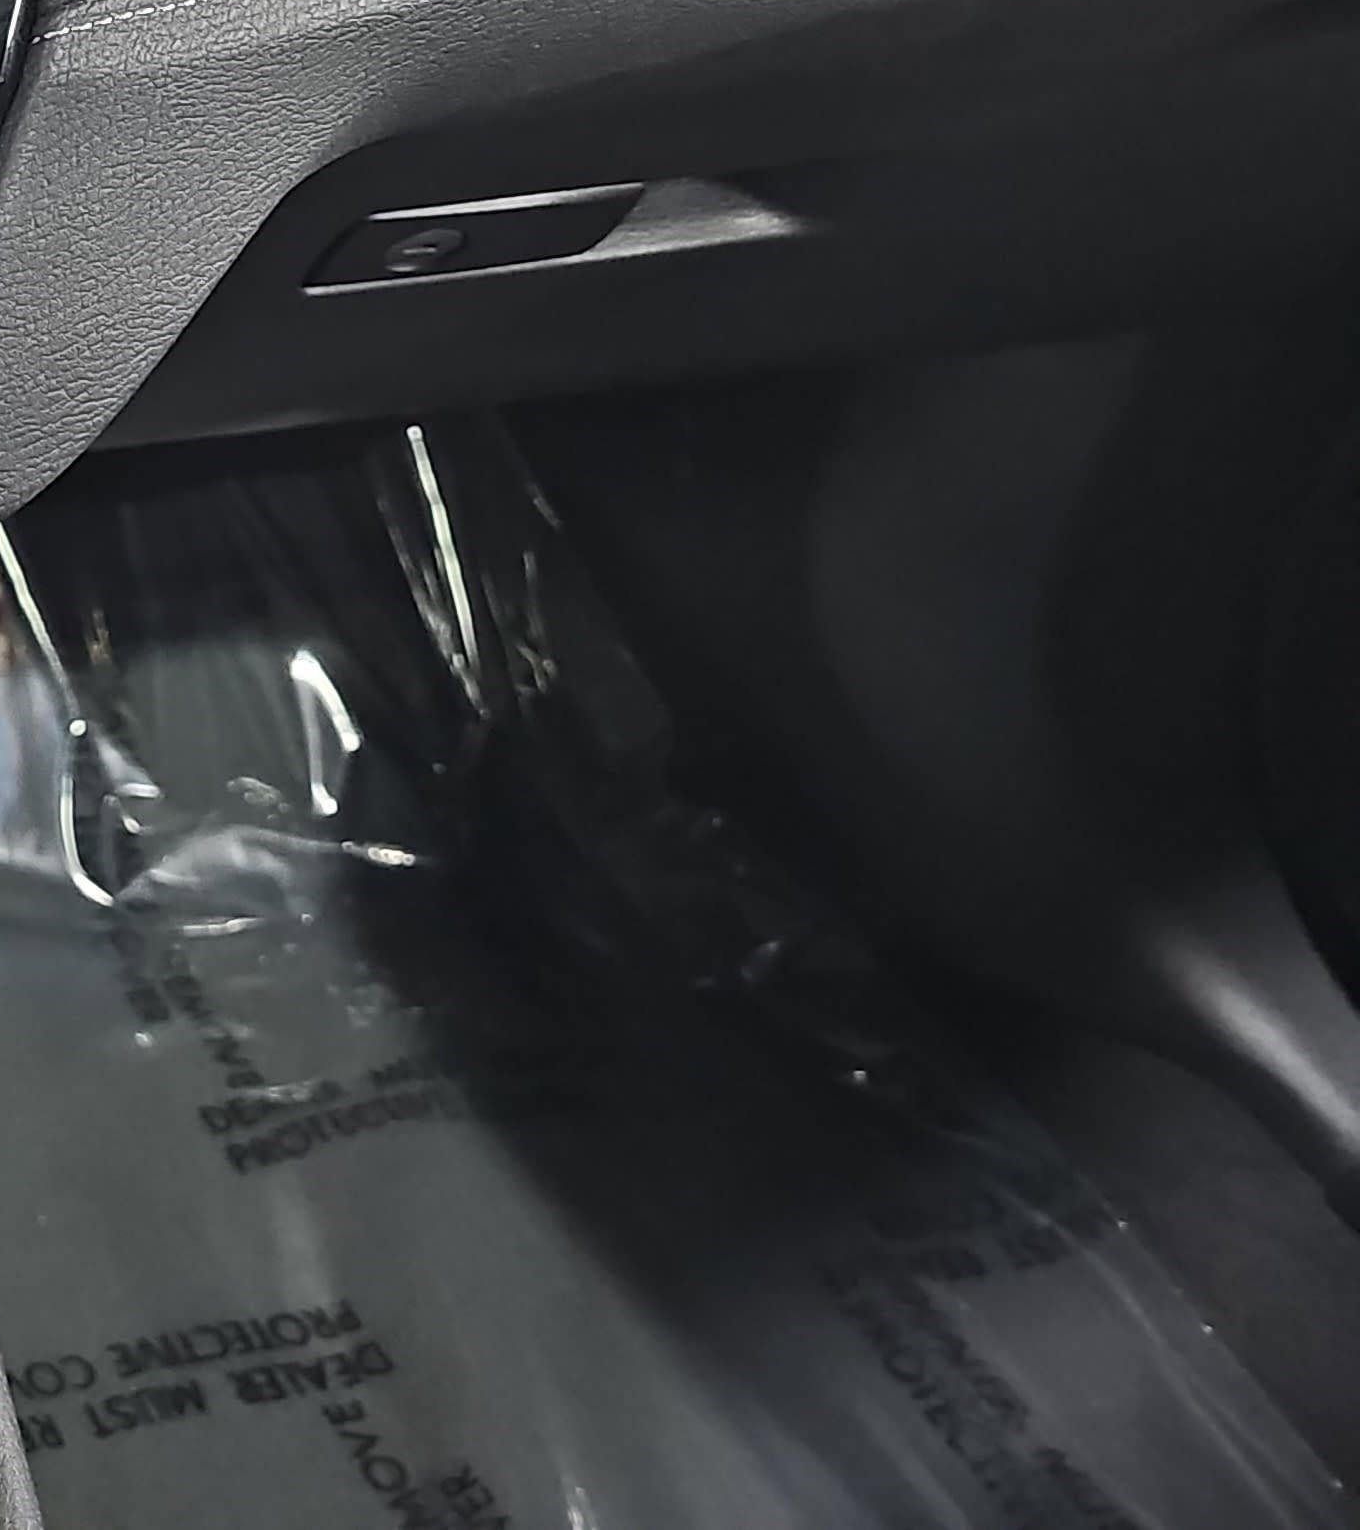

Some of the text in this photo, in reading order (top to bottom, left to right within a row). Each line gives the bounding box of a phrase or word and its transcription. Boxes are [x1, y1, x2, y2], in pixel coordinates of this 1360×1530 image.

[108, 1299, 363, 1372] PROTECTIVE
[228, 1339, 394, 1407] DEALER
[86, 1380, 210, 1440] MUST
